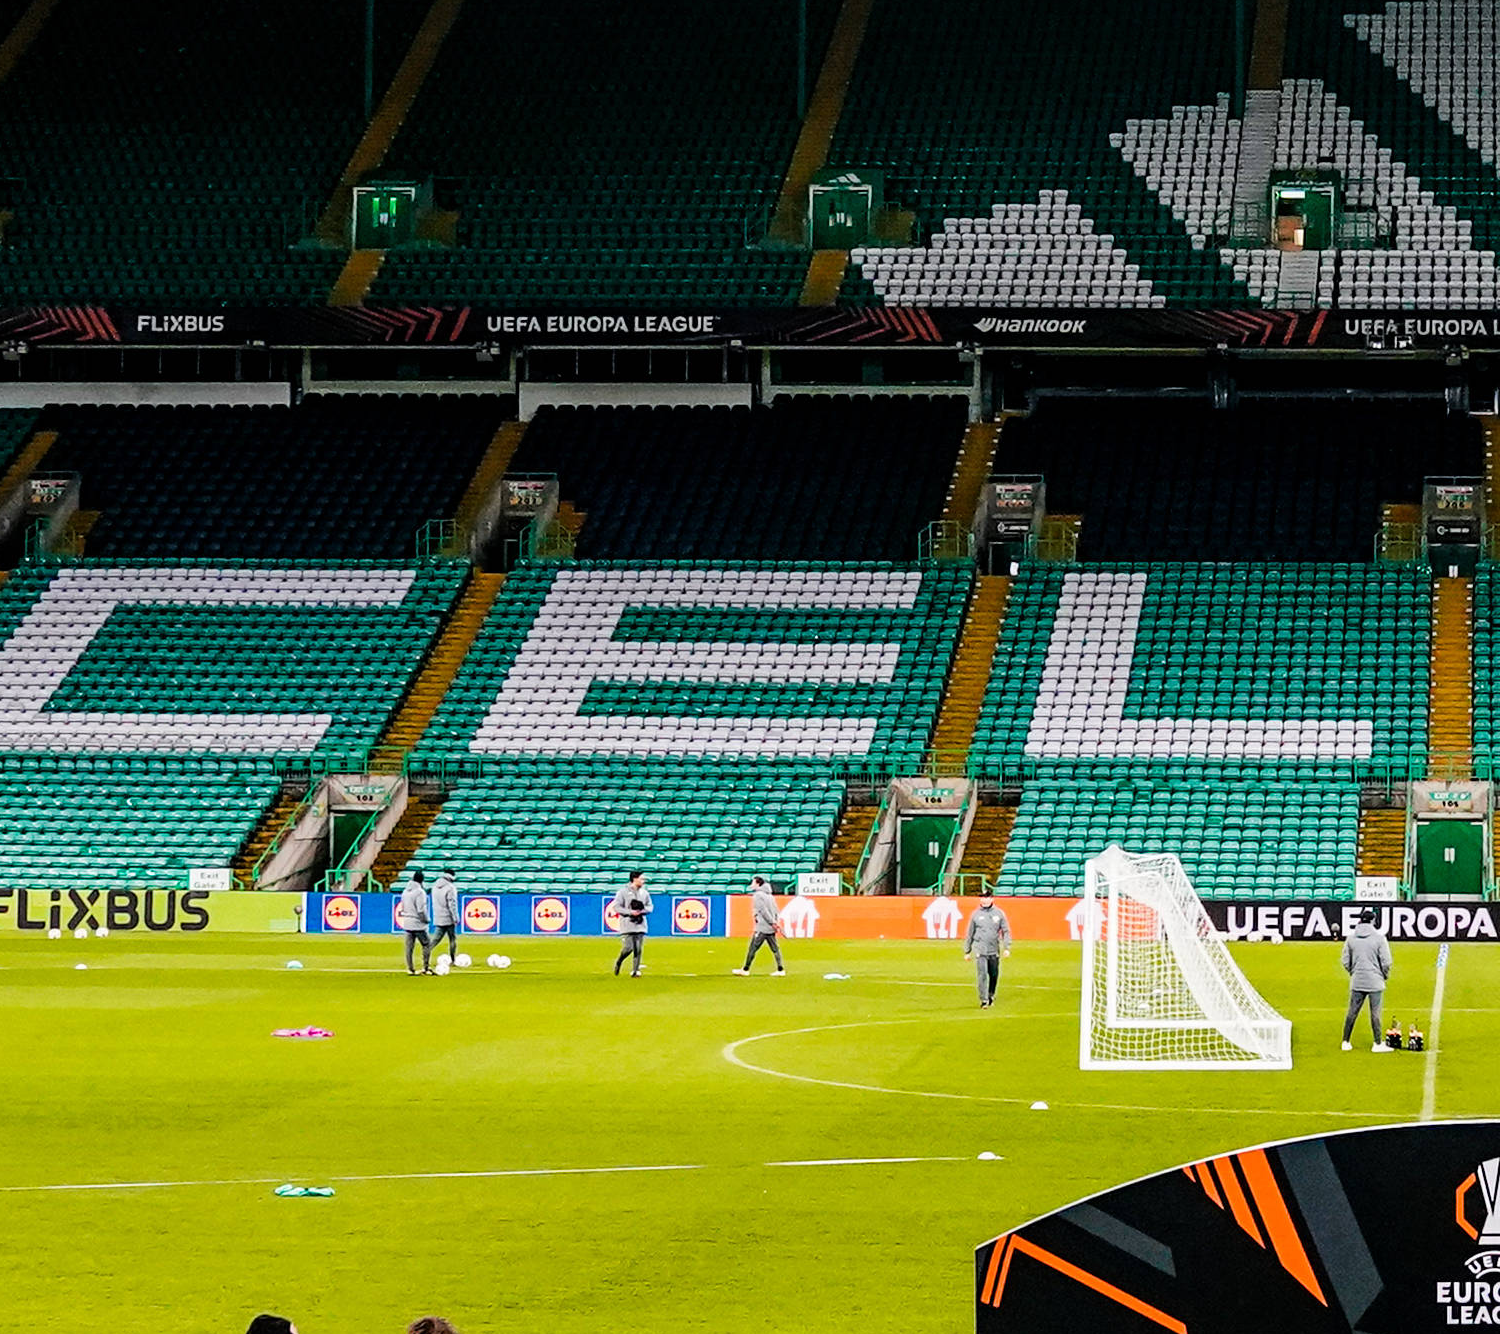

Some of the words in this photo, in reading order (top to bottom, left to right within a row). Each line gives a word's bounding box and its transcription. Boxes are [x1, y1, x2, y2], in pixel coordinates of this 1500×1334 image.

[488, 316, 541, 333] UEFA
[547, 316, 629, 333] EUROPA
[1344, 319, 1398, 336] UEFA
[1405, 319, 1487, 336] EUROPA
[1228, 906, 1327, 939] UEFA
